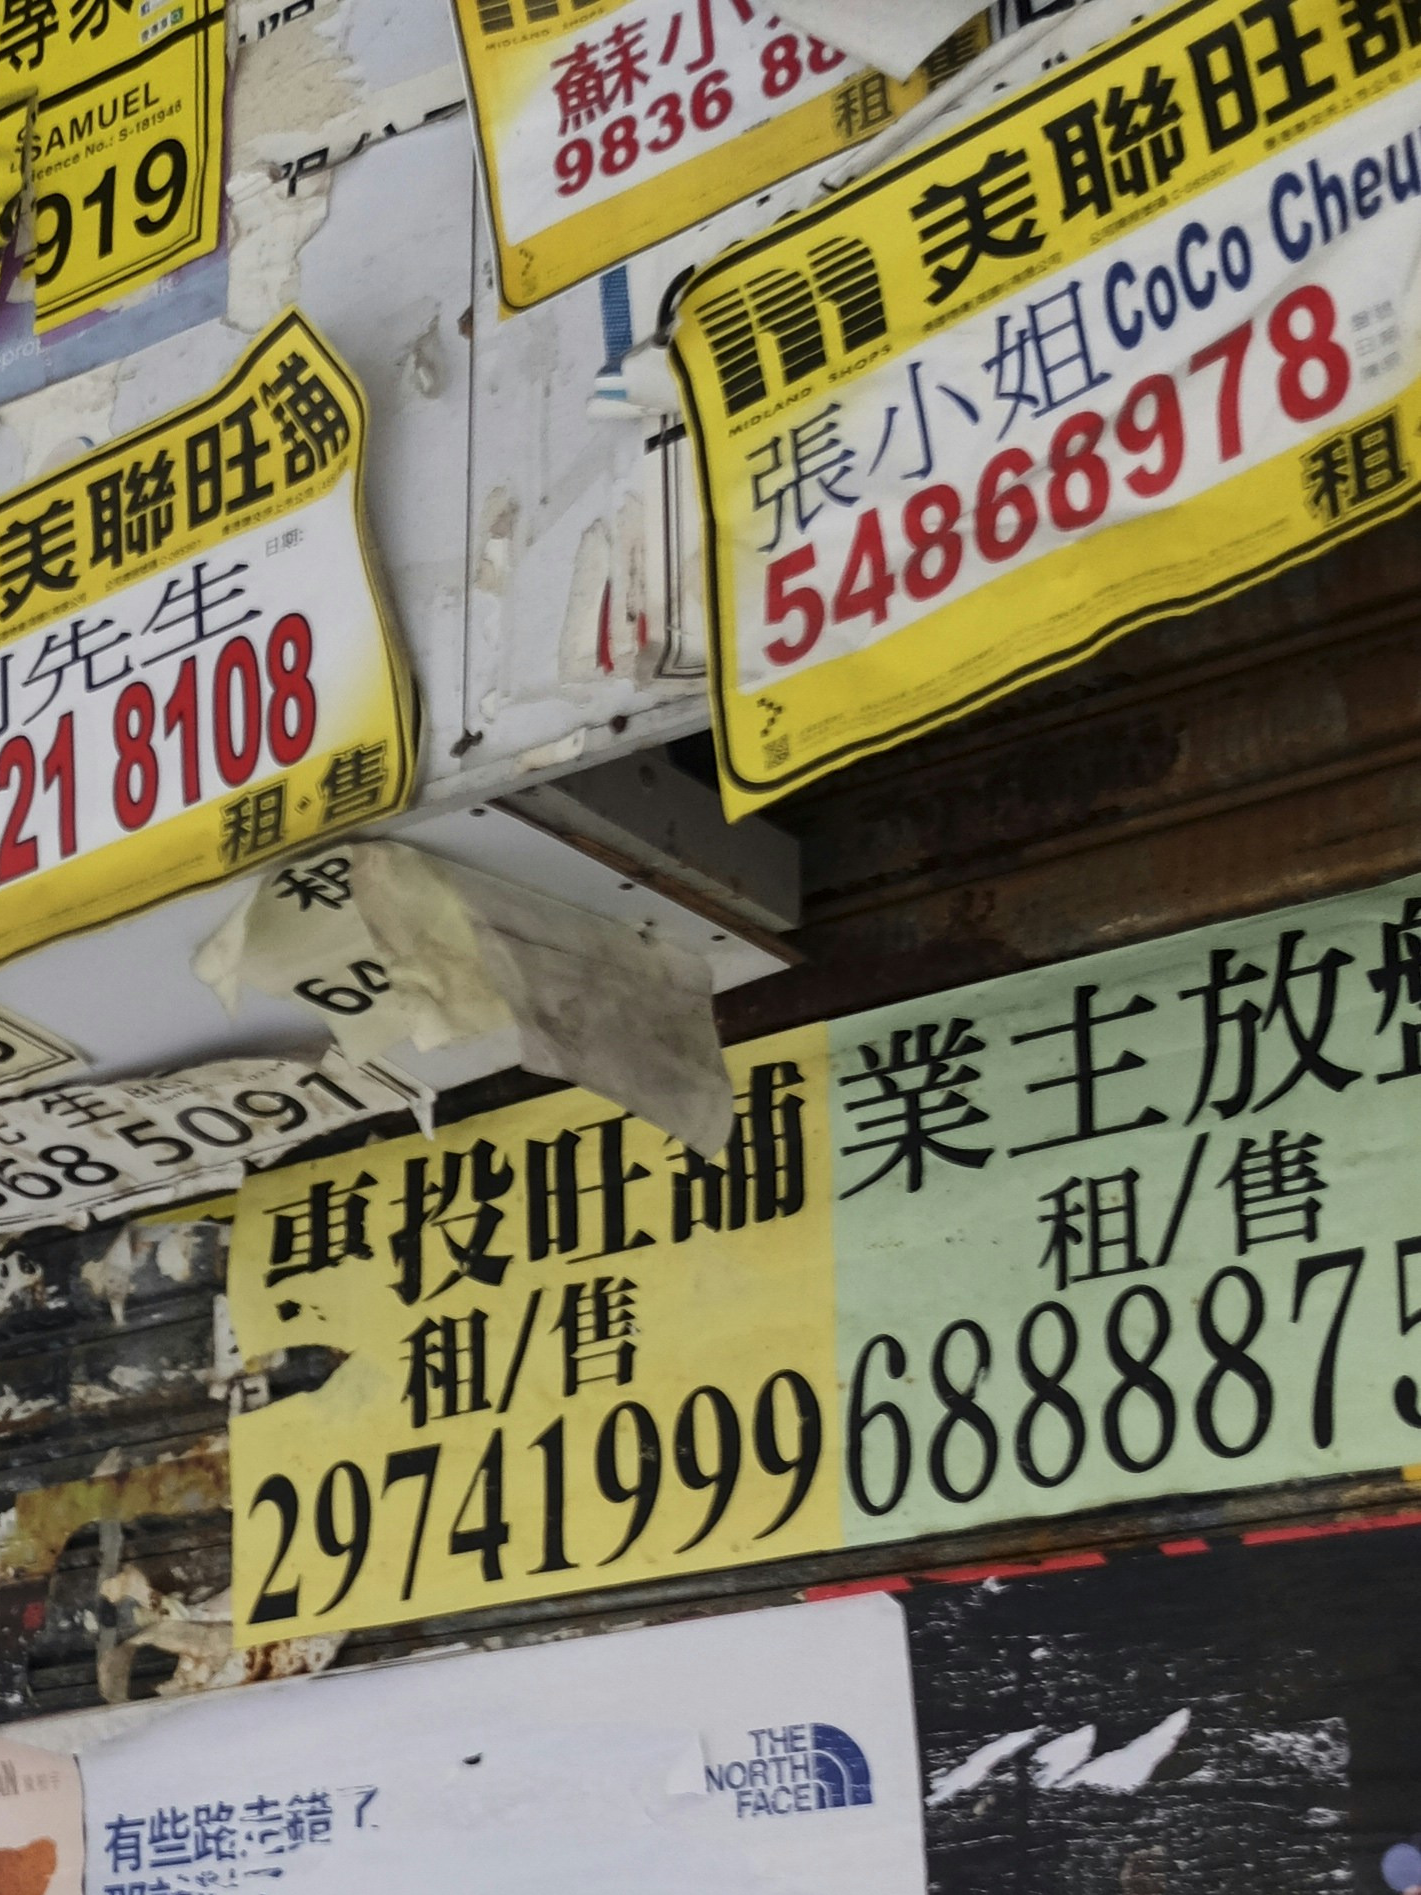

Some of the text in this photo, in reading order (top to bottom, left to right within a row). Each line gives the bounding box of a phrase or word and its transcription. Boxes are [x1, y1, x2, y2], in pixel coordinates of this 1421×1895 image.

[552, 68, 736, 197] 9836
[1102, 221, 1253, 351] CoCo
[1268, 124, 1421, 264] Cheu
[745, 281, 1113, 554] 張小姐
[762, 284, 1351, 667] 54868978
[1300, 406, 1411, 524] 租
[112, 611, 317, 834] 8108
[115, 1070, 368, 1168] 5091
[1037, 1129, 1328, 1290] 租/售
[401, 1276, 640, 1429] 租/售
[246, 1368, 823, 1626] 29741999
[704, 1752, 813, 1794] NORTH
[736, 1783, 814, 1820] FACE
[748, 1723, 810, 1754] THE
